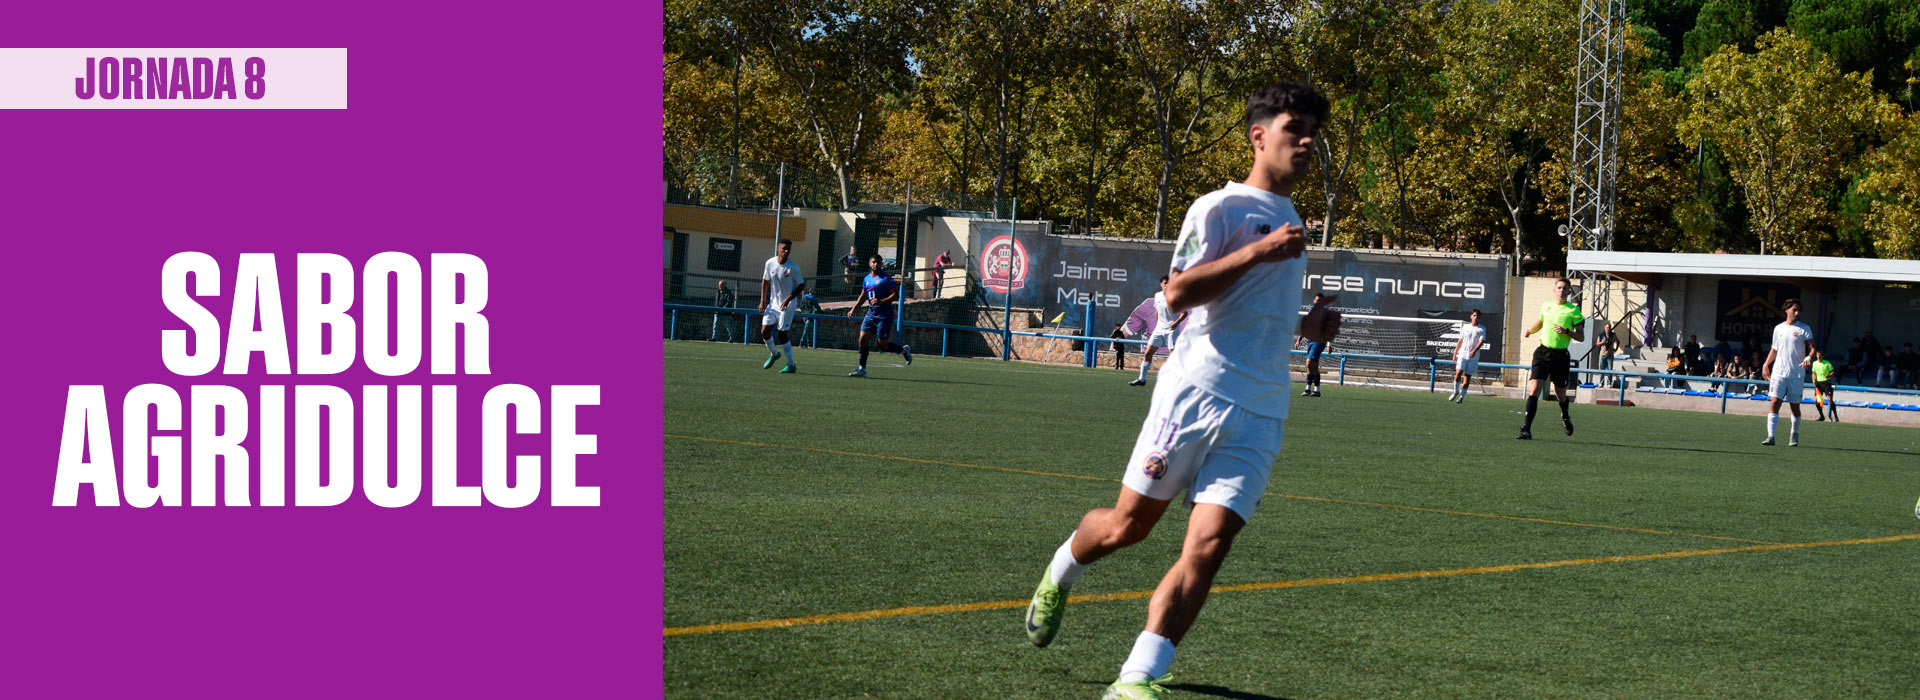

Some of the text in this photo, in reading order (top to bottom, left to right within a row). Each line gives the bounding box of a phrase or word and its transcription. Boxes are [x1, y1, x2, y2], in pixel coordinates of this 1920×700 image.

[1053, 261, 1128, 281] Jaime
[1057, 287, 1121, 308] Mata
[1375, 278, 1485, 299] nunca
